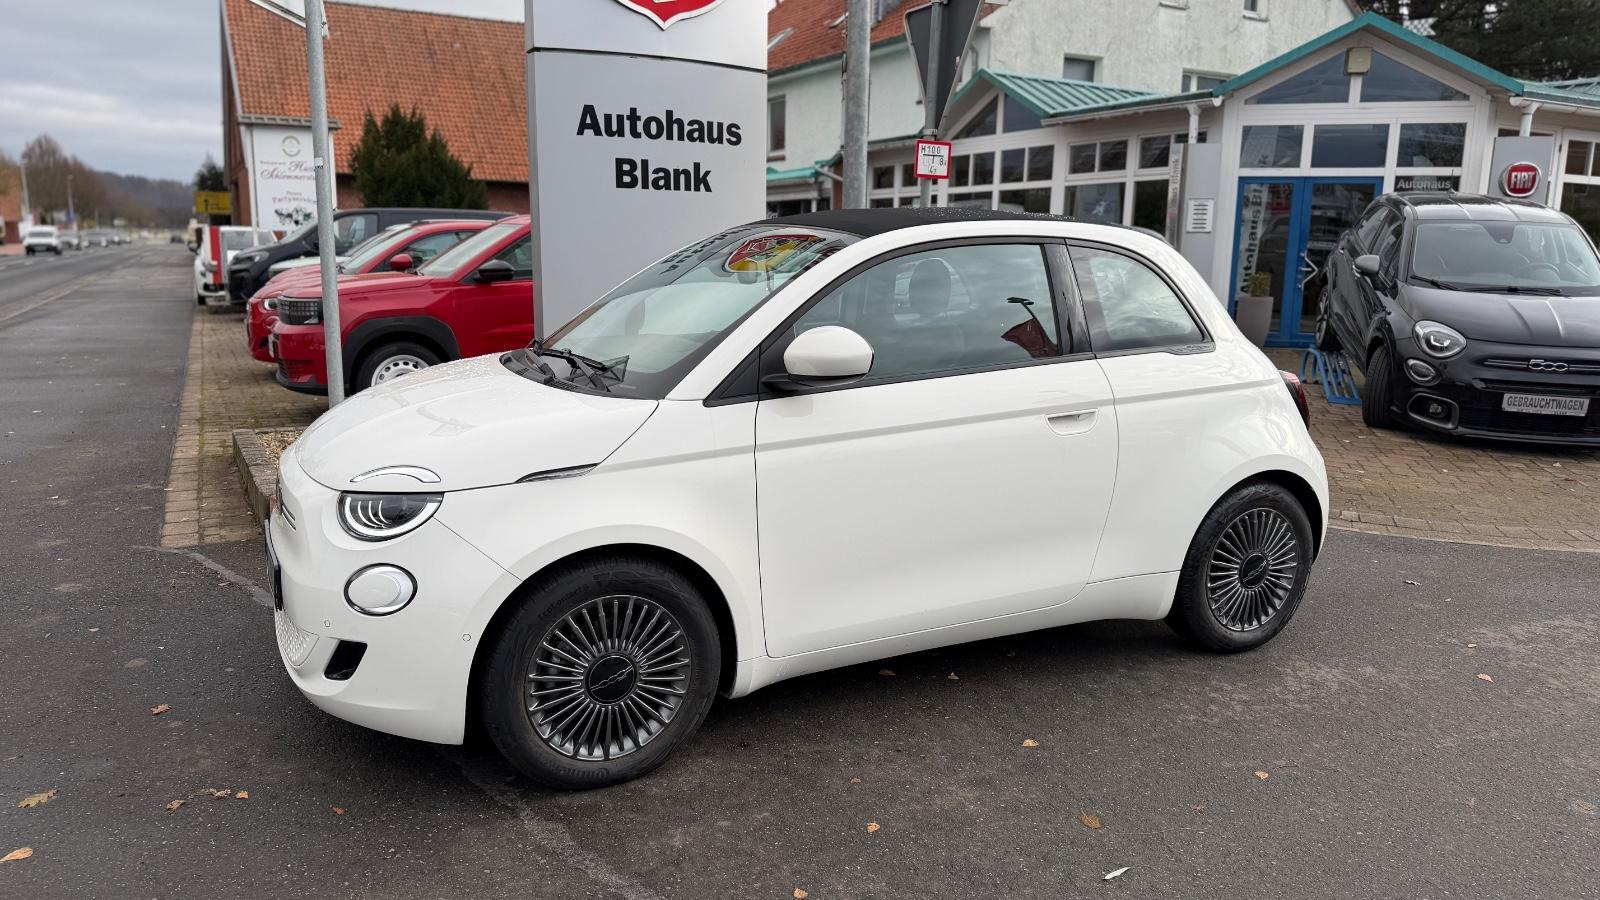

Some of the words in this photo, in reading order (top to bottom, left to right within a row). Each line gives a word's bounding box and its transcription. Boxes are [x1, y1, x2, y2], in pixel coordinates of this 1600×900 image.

[576, 104, 742, 146] Autohaus
[615, 157, 712, 192] Blank
[1510, 171, 1536, 189] FIAT
[1396, 178, 1451, 190] Autohaus
[1240, 207, 1262, 295] Autohaus
[1528, 359, 1569, 372] 500
[1506, 395, 1585, 411] GEBRAUCHTWAGEN
